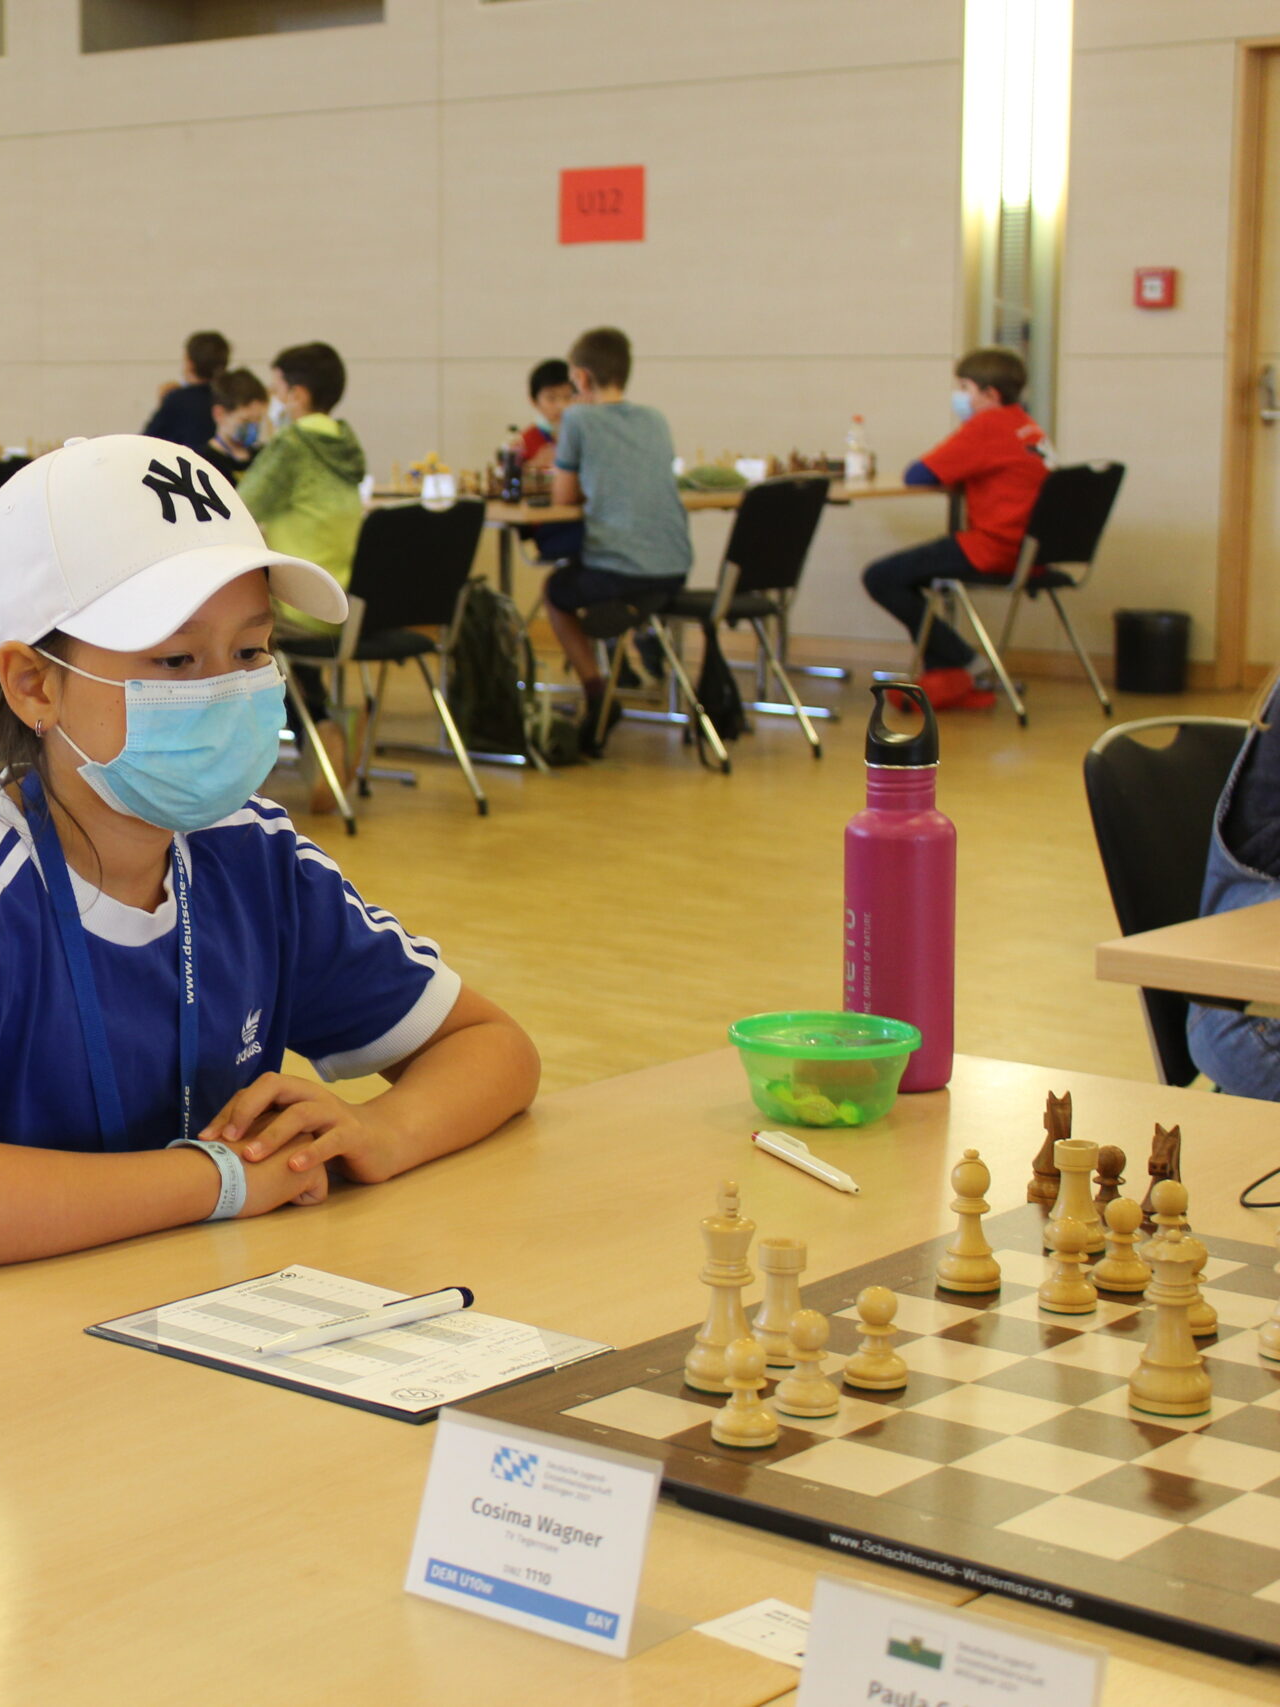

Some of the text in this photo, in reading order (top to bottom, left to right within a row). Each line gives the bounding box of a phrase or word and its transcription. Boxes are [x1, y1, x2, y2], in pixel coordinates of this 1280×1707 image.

[576, 187, 625, 215] U12
[141, 455, 231, 524] NY
[471, 1496, 603, 1548] Cosima Wagner
[430, 1563, 458, 1584] DEM
[525, 1566, 552, 1587] 1110
[585, 1610, 615, 1632] BAY
